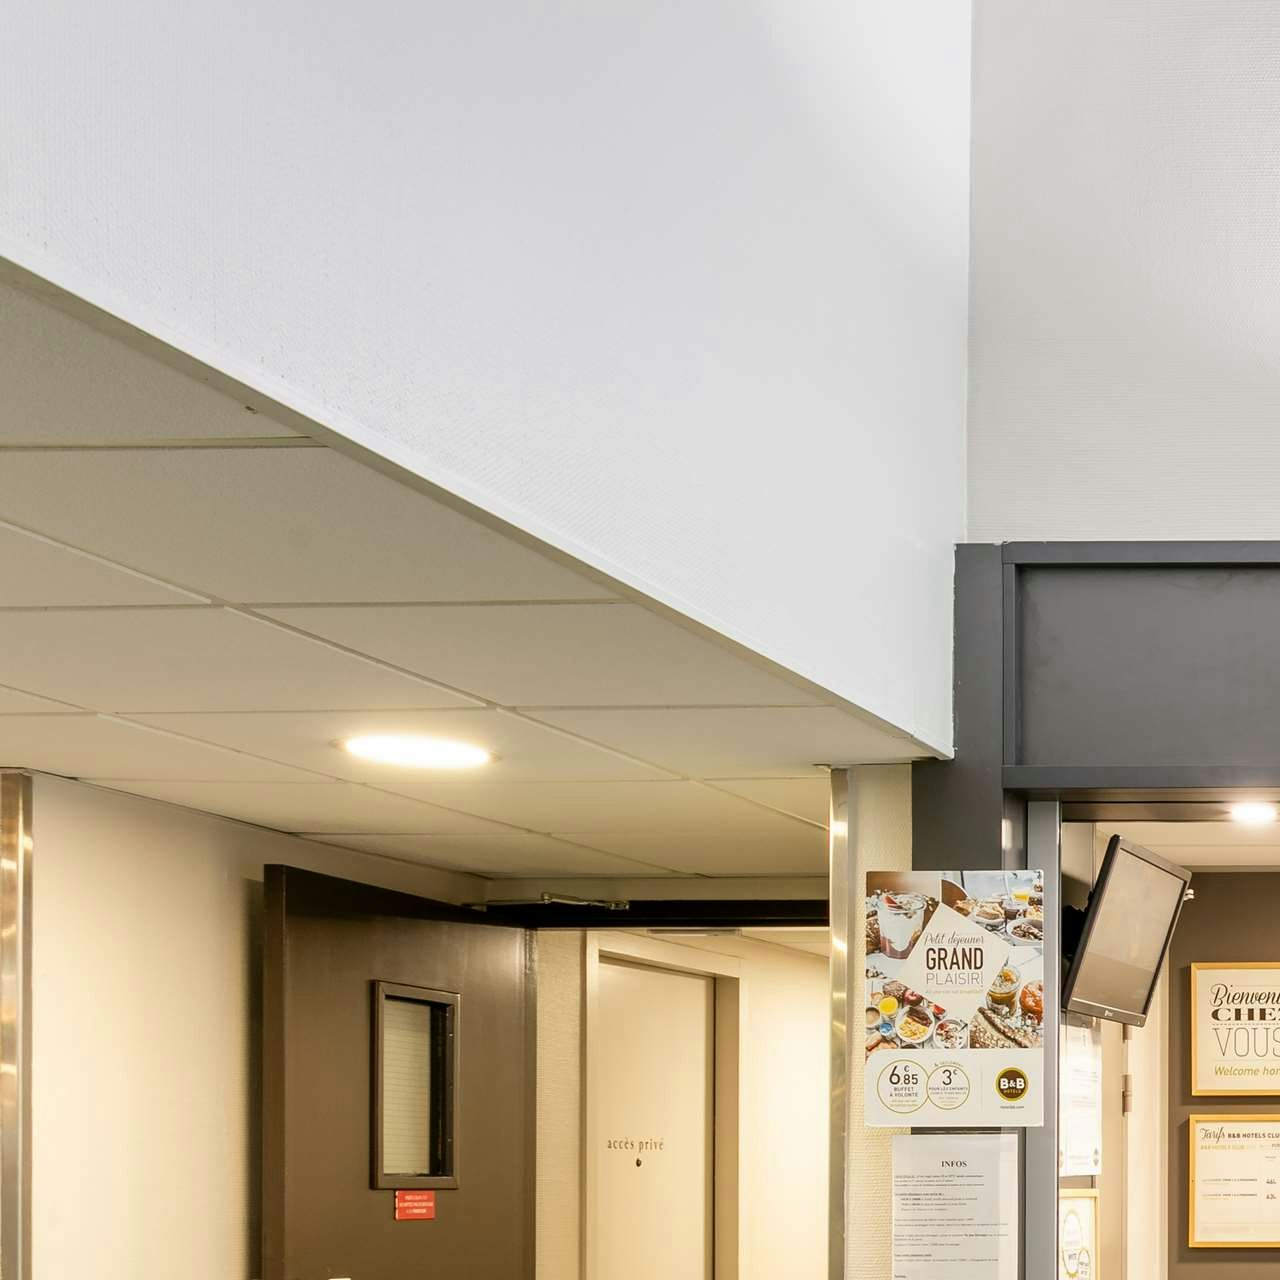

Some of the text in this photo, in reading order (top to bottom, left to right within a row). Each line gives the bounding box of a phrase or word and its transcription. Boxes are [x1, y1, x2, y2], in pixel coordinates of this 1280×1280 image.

[924, 930, 984, 948] Petit déjeuner
[926, 947, 984, 970] GRAND
[926, 972, 983, 988] PLAISIR!
[942, 1069, 952, 1086] 3
[1214, 1066, 1259, 1076] Welcome
[1000, 1077, 1025, 1089] B&B
[1200, 1127, 1225, 1144] Tarifs
[607, 1136, 664, 1153] accès privé
[941, 1160, 968, 1168] INFOS
